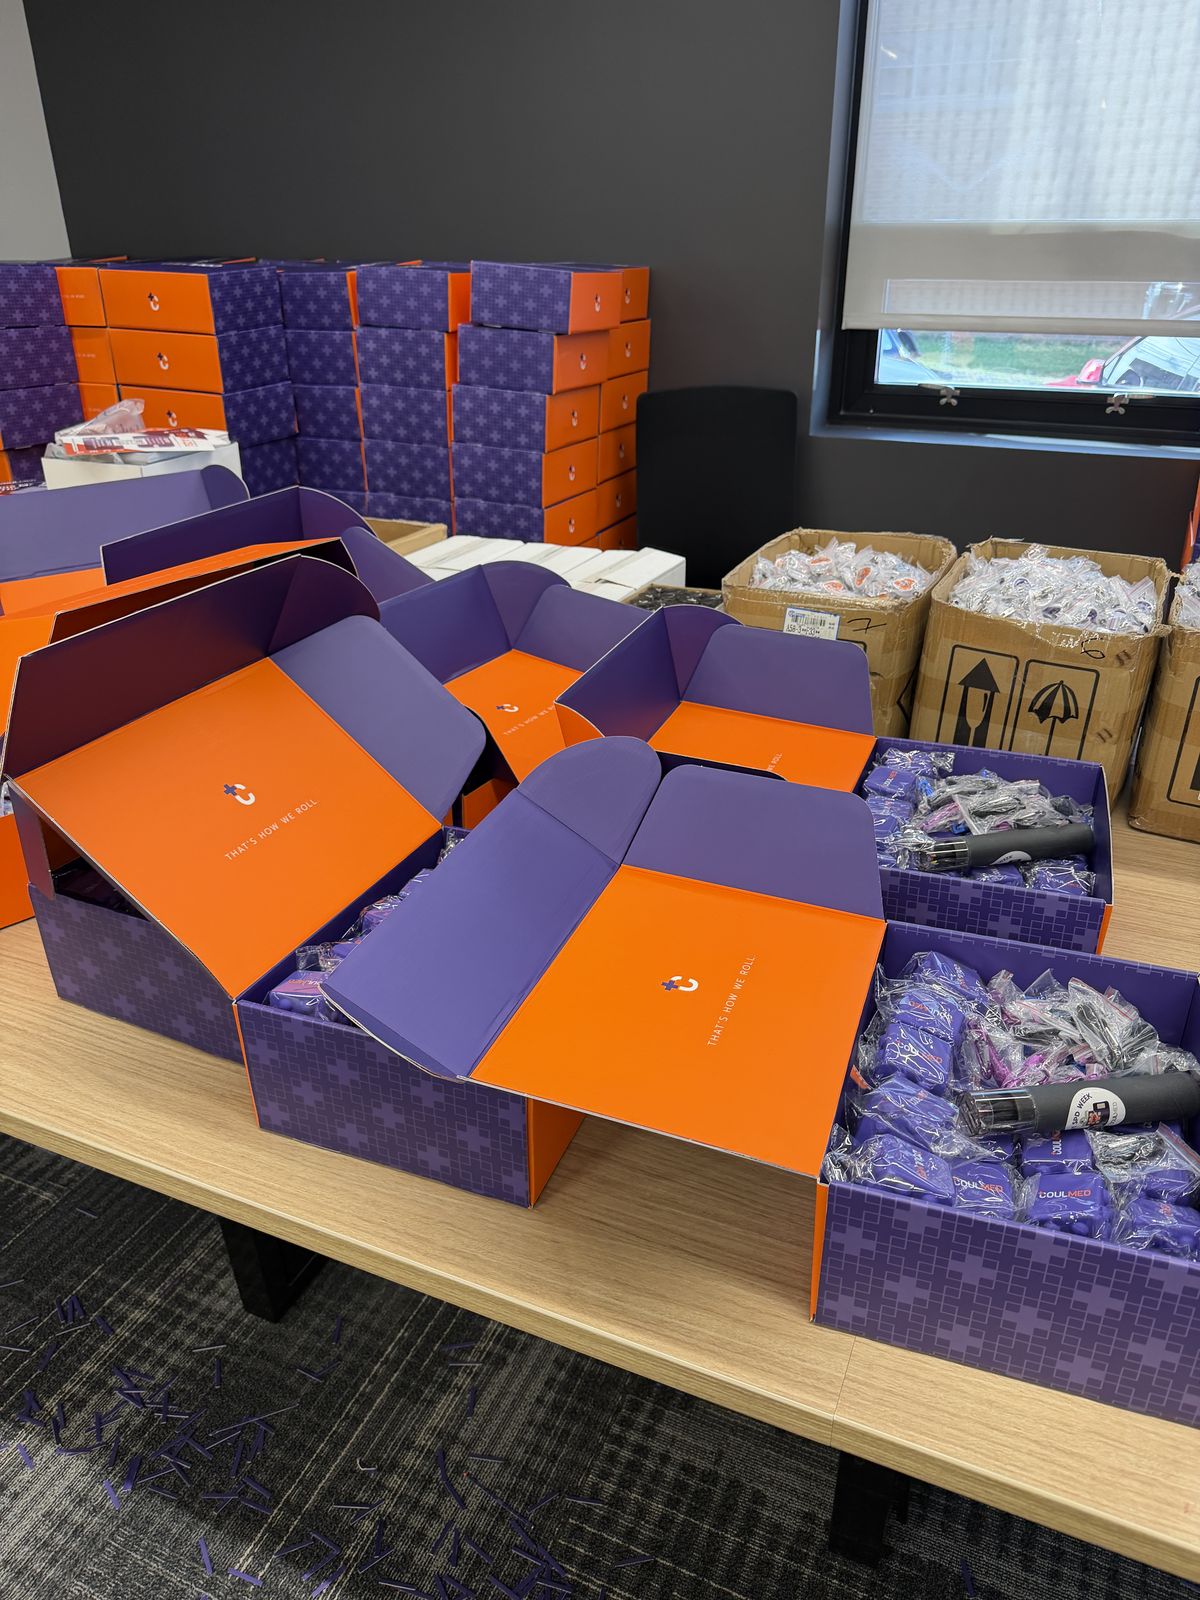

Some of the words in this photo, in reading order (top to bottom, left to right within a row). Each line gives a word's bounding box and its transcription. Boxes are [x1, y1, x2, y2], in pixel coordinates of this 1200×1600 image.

[846, 617, 887, 635] 7
[1080, 637, 1105, 659] 6
[225, 837, 258, 861] THAT'S
[258, 822, 280, 840] HOW
[280, 812, 296, 825] WE
[295, 799, 318, 815] ROLL
[707, 1015, 729, 1046] THAT'S
[722, 993, 738, 1014] HOW
[733, 977, 746, 991] WE
[740, 956, 756, 976] ROLL
[1076, 1092, 1093, 1110] WEEK
[1072, 1111, 1081, 1125] SPD
[952, 1176, 1004, 1194] COULMED
[1039, 1189, 1092, 1199] COULMED
